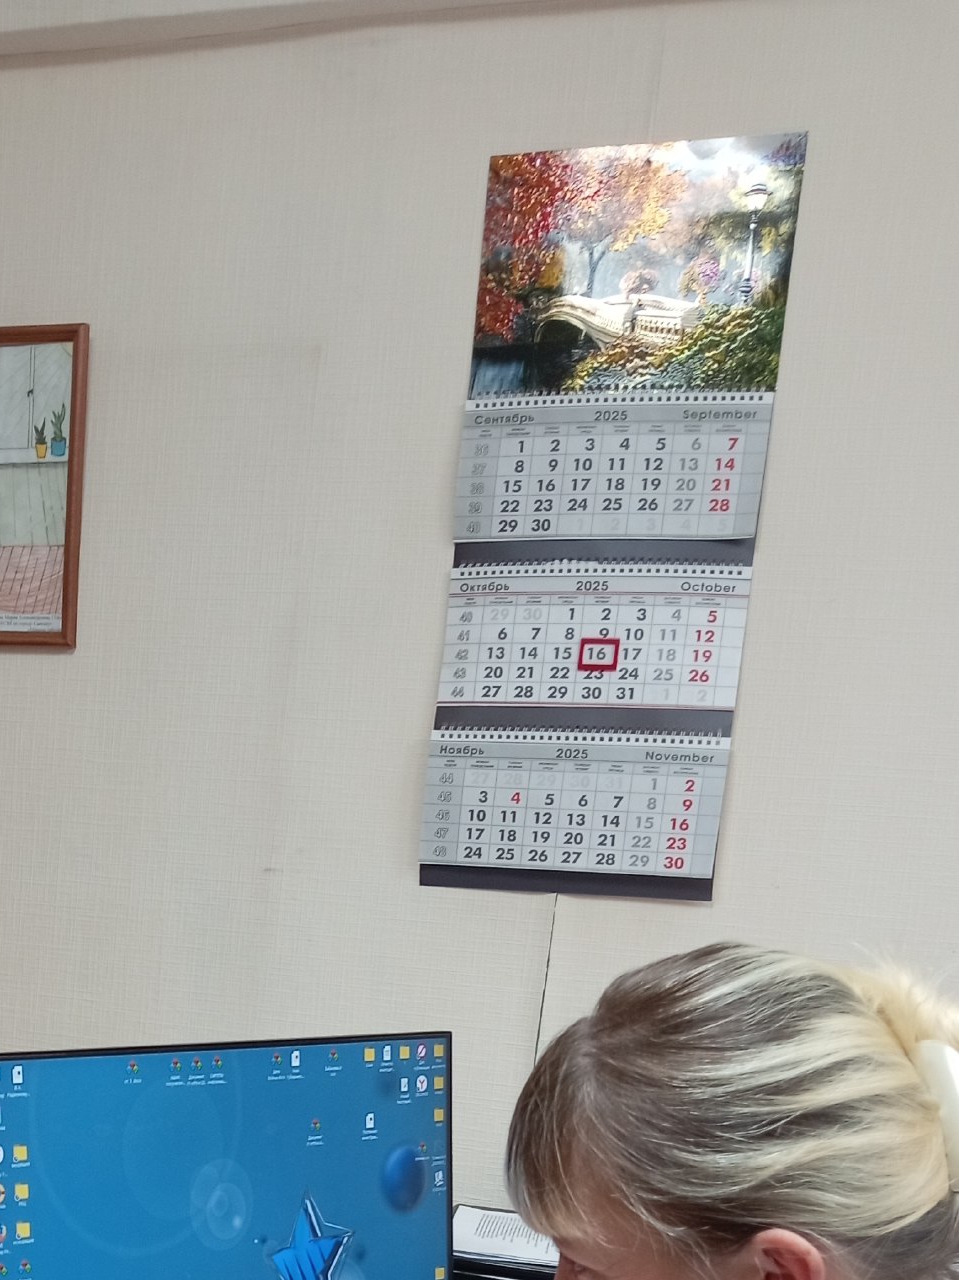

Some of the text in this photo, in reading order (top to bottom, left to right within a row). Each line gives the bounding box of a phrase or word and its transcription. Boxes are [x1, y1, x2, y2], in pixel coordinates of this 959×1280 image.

[474, 410, 628, 426] Сентябрь 2025
[683, 409, 758, 421] September
[518, 440, 525, 453] 1
[549, 439, 561, 453] 2
[584, 438, 595, 452] 3
[619, 437, 630, 451] 4
[655, 437, 667, 451] 5
[691, 437, 702, 451] 6
[728, 437, 739, 451] 7
[514, 459, 525, 474] 8
[548, 458, 559, 472] 9
[573, 457, 593, 472] 10
[608, 457, 625, 471] 11
[644, 457, 664, 471] 12
[679, 457, 699, 472] 13
[715, 457, 735, 471] 14
[503, 479, 523, 493] 15
[537, 478, 556, 493] 16
[571, 478, 592, 492] 17
[606, 477, 625, 491] 18
[641, 477, 662, 491] 19
[675, 478, 697, 492] 20
[710, 478, 731, 492] 21
[500, 499, 520, 513] 22
[533, 498, 553, 513] 23
[566, 498, 588, 512] 24
[601, 497, 623, 511] 25
[637, 497, 659, 511] 26
[672, 498, 695, 512] 27
[708, 498, 730, 512] 28
[497, 519, 518, 533] 29
[531, 518, 551, 532] 30
[459, 580, 609, 594] Октябрь 2025
[680, 581, 737, 593] October
[569, 607, 575, 621] 1
[600, 607, 612, 621] 2
[636, 607, 647, 622] 3
[671, 608, 682, 622] 4
[707, 610, 718, 624] 5
[497, 627, 508, 641] 6
[531, 627, 542, 641] 7
[564, 627, 575, 641] 8
[599, 627, 610, 639] 9
[624, 628, 644, 641] 10
[660, 628, 677, 642] 11
[695, 629, 715, 643] 12
[487, 646, 505, 660] 13
[519, 646, 538, 660] 14
[553, 646, 572, 660] 15
[587, 647, 606, 661] 16
[622, 647, 643, 661] 17
[657, 648, 677, 662] 18
[693, 649, 713, 663] 19
[483, 666, 504, 679] 20
[515, 666, 534, 679] 21
[549, 666, 570, 679] 22
[583, 670, 604, 680] 23
[618, 667, 639, 681] 24
[652, 668, 674, 682] 25
[688, 669, 710, 683] 26
[481, 685, 502, 698] 27
[513, 685, 534, 699] 28
[547, 685, 568, 699] 29
[581, 686, 602, 700] 30
[615, 687, 635, 700] 31
[439, 745, 589, 760] Ноябрь 2025
[645, 752, 714, 763] November
[651, 777, 658, 791] 1
[684, 779, 695, 792] 2
[478, 790, 488, 804] 3
[510, 792, 521, 805] 4
[544, 793, 555, 806] 5
[578, 794, 588, 807] 6
[613, 795, 624, 809] 7
[646, 797, 657, 810] 8
[682, 799, 693, 812] 9
[468, 809, 487, 822] 10
[500, 810, 517, 823] 11
[534, 811, 553, 825] 12
[566, 813, 586, 827] 13
[601, 814, 621, 828] 14
[635, 816, 655, 830] 15
[670, 817, 689, 832] 16
[466, 827, 486, 841] 17
[498, 829, 517, 842] 18
[532, 830, 551, 844] 19
[563, 831, 584, 845] 20
[597, 833, 616, 847] 21
[630, 835, 652, 849] 22
[665, 836, 687, 851] 23
[463, 846, 483, 859] 24
[495, 847, 515, 861] 25
[527, 849, 548, 863] 26
[560, 850, 583, 864] 27
[595, 852, 616, 866] 28
[628, 854, 650, 868] 29
[663, 856, 684, 870] 30
